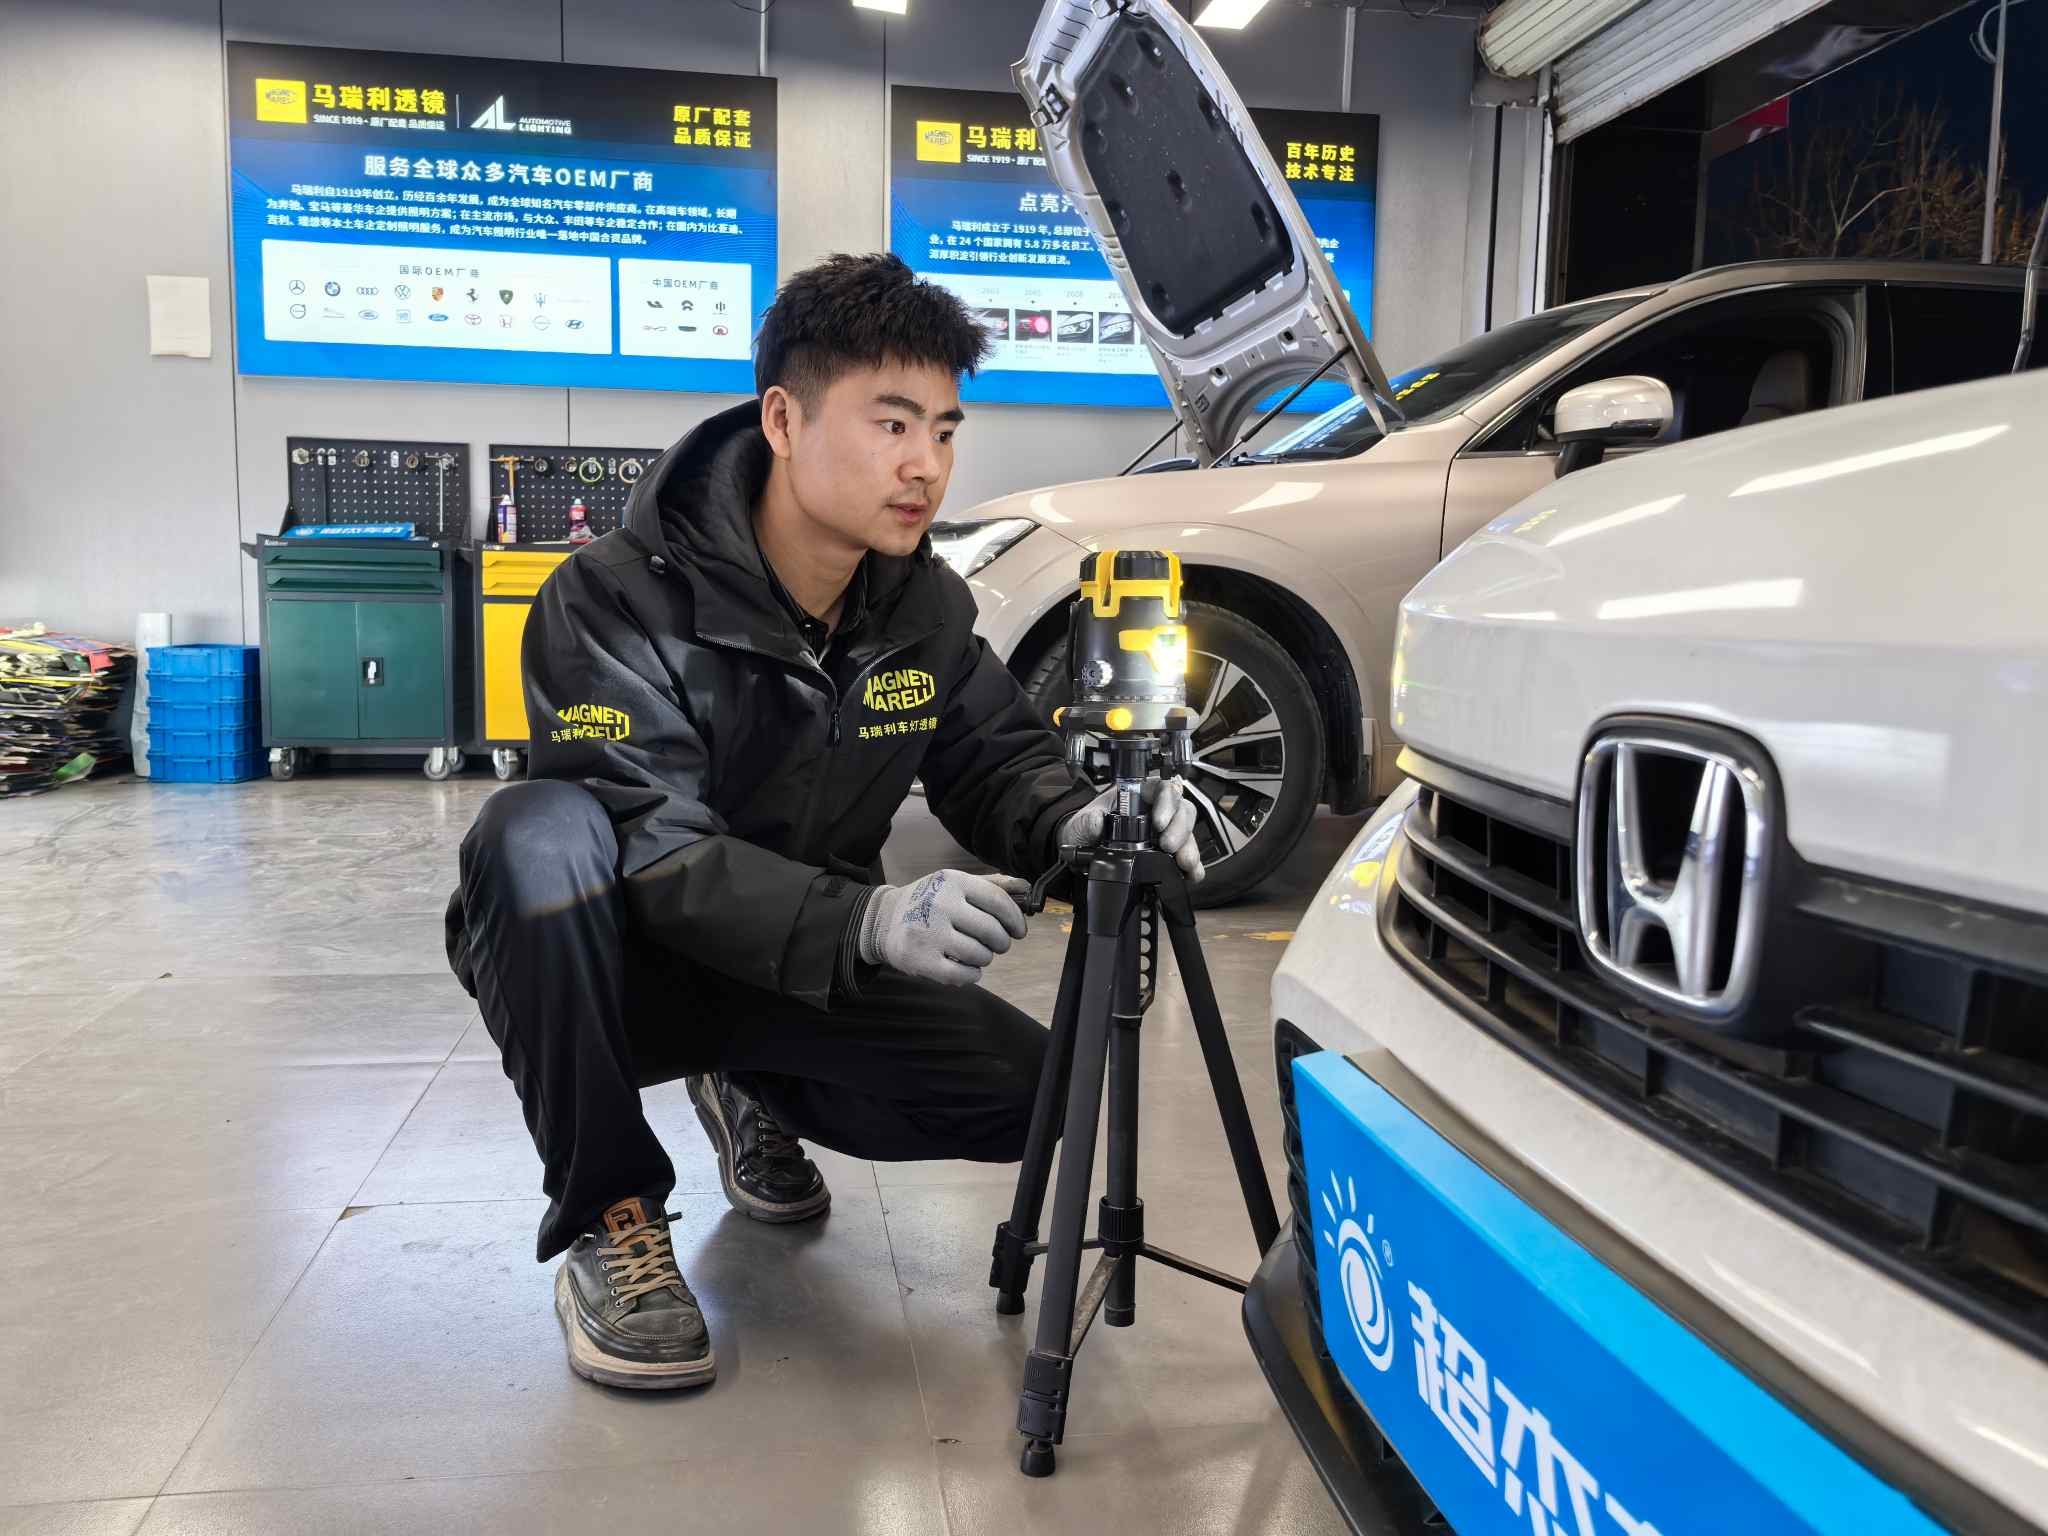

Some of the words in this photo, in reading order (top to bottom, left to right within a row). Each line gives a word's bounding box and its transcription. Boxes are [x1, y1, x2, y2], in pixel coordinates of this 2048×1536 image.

[312, 83, 446, 115] 马瑞利透镜
[313, 113, 340, 124] SINCE
[519, 117, 571, 127] AUTOMOTIVE
[673, 105, 751, 127] 原厂配套
[519, 124, 571, 135] LIGHTING
[673, 127, 751, 148] 品质保证
[966, 125, 1043, 152] 马瑞利
[966, 154, 990, 164] SINCE
[991, 155, 1010, 165] 1919
[1286, 142, 1355, 162] 百年历史
[364, 155, 654, 192] 服务全球众多汽车OEM厂商
[1285, 162, 1354, 182] 技术专注
[952, 220, 1012, 234] 马瑞利成立于
[1013, 224, 1036, 234] 1919
[959, 236, 971, 246] 24
[1024, 239, 1040, 249] 5.8
[858, 717, 938, 740] 马瑞利车灯透镜
